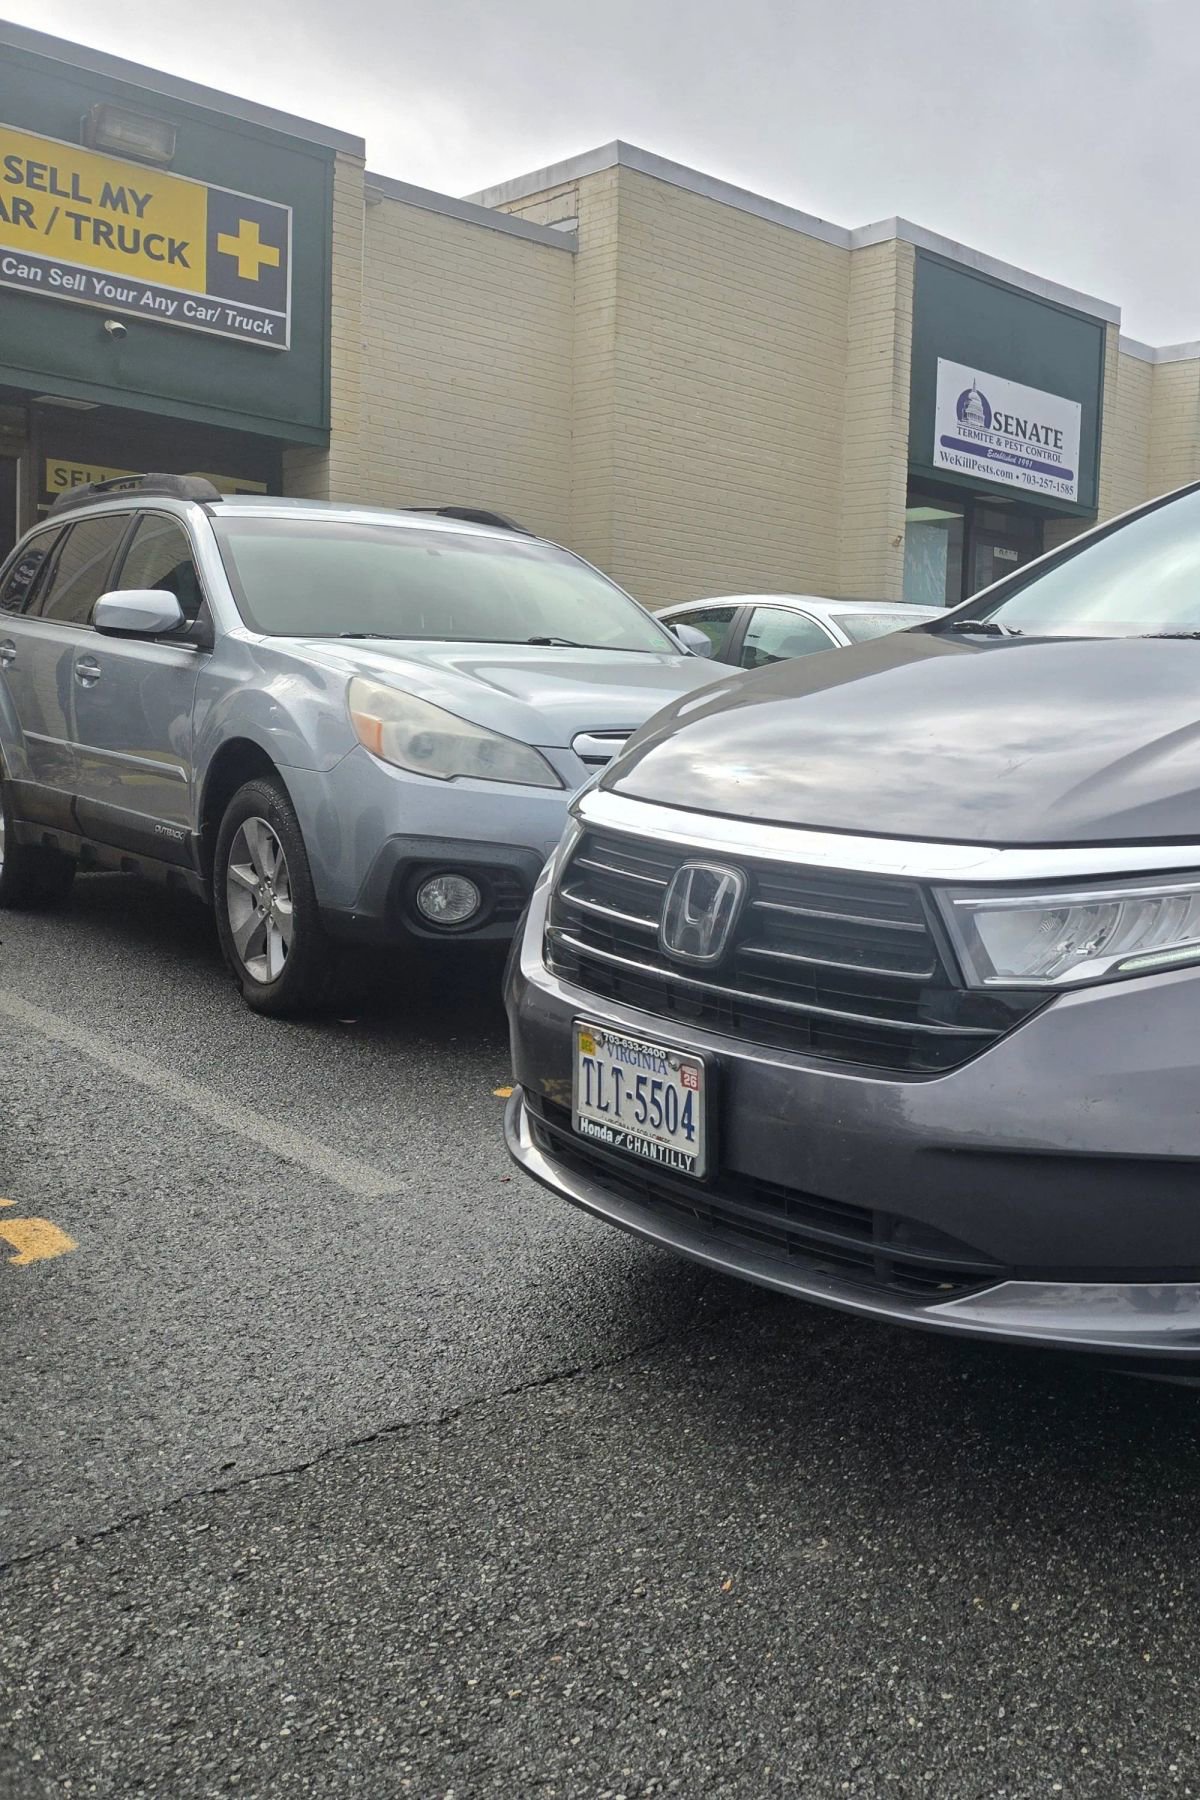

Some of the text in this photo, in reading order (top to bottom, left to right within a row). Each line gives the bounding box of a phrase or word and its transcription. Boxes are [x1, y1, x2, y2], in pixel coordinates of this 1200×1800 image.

[3, 155, 153, 219] SELL MY
[65, 211, 191, 269] TRUCK
[1, 257, 42, 281] Can
[48, 268, 86, 291] Sell
[92, 277, 137, 303] Your
[140, 290, 178, 316] Any
[225, 309, 274, 335] Truck
[957, 427, 1062, 464] TERMITE & PEST CONTROL
[992, 411, 1063, 449] SENATE
[939, 450, 1074, 496] WeKillPests.com 703-257-1585
[1017, 457, 1033, 468] 1991
[603, 1033, 666, 1059] 703-633-2400
[605, 1043, 668, 1076] VIRGINIA
[582, 1057, 695, 1142] TLT-5504
[683, 1073, 697, 1088] 26
[580, 1117, 613, 1144] Honda
[614, 1132, 626, 1145] of
[626, 1134, 693, 1171] CHANTILLY
